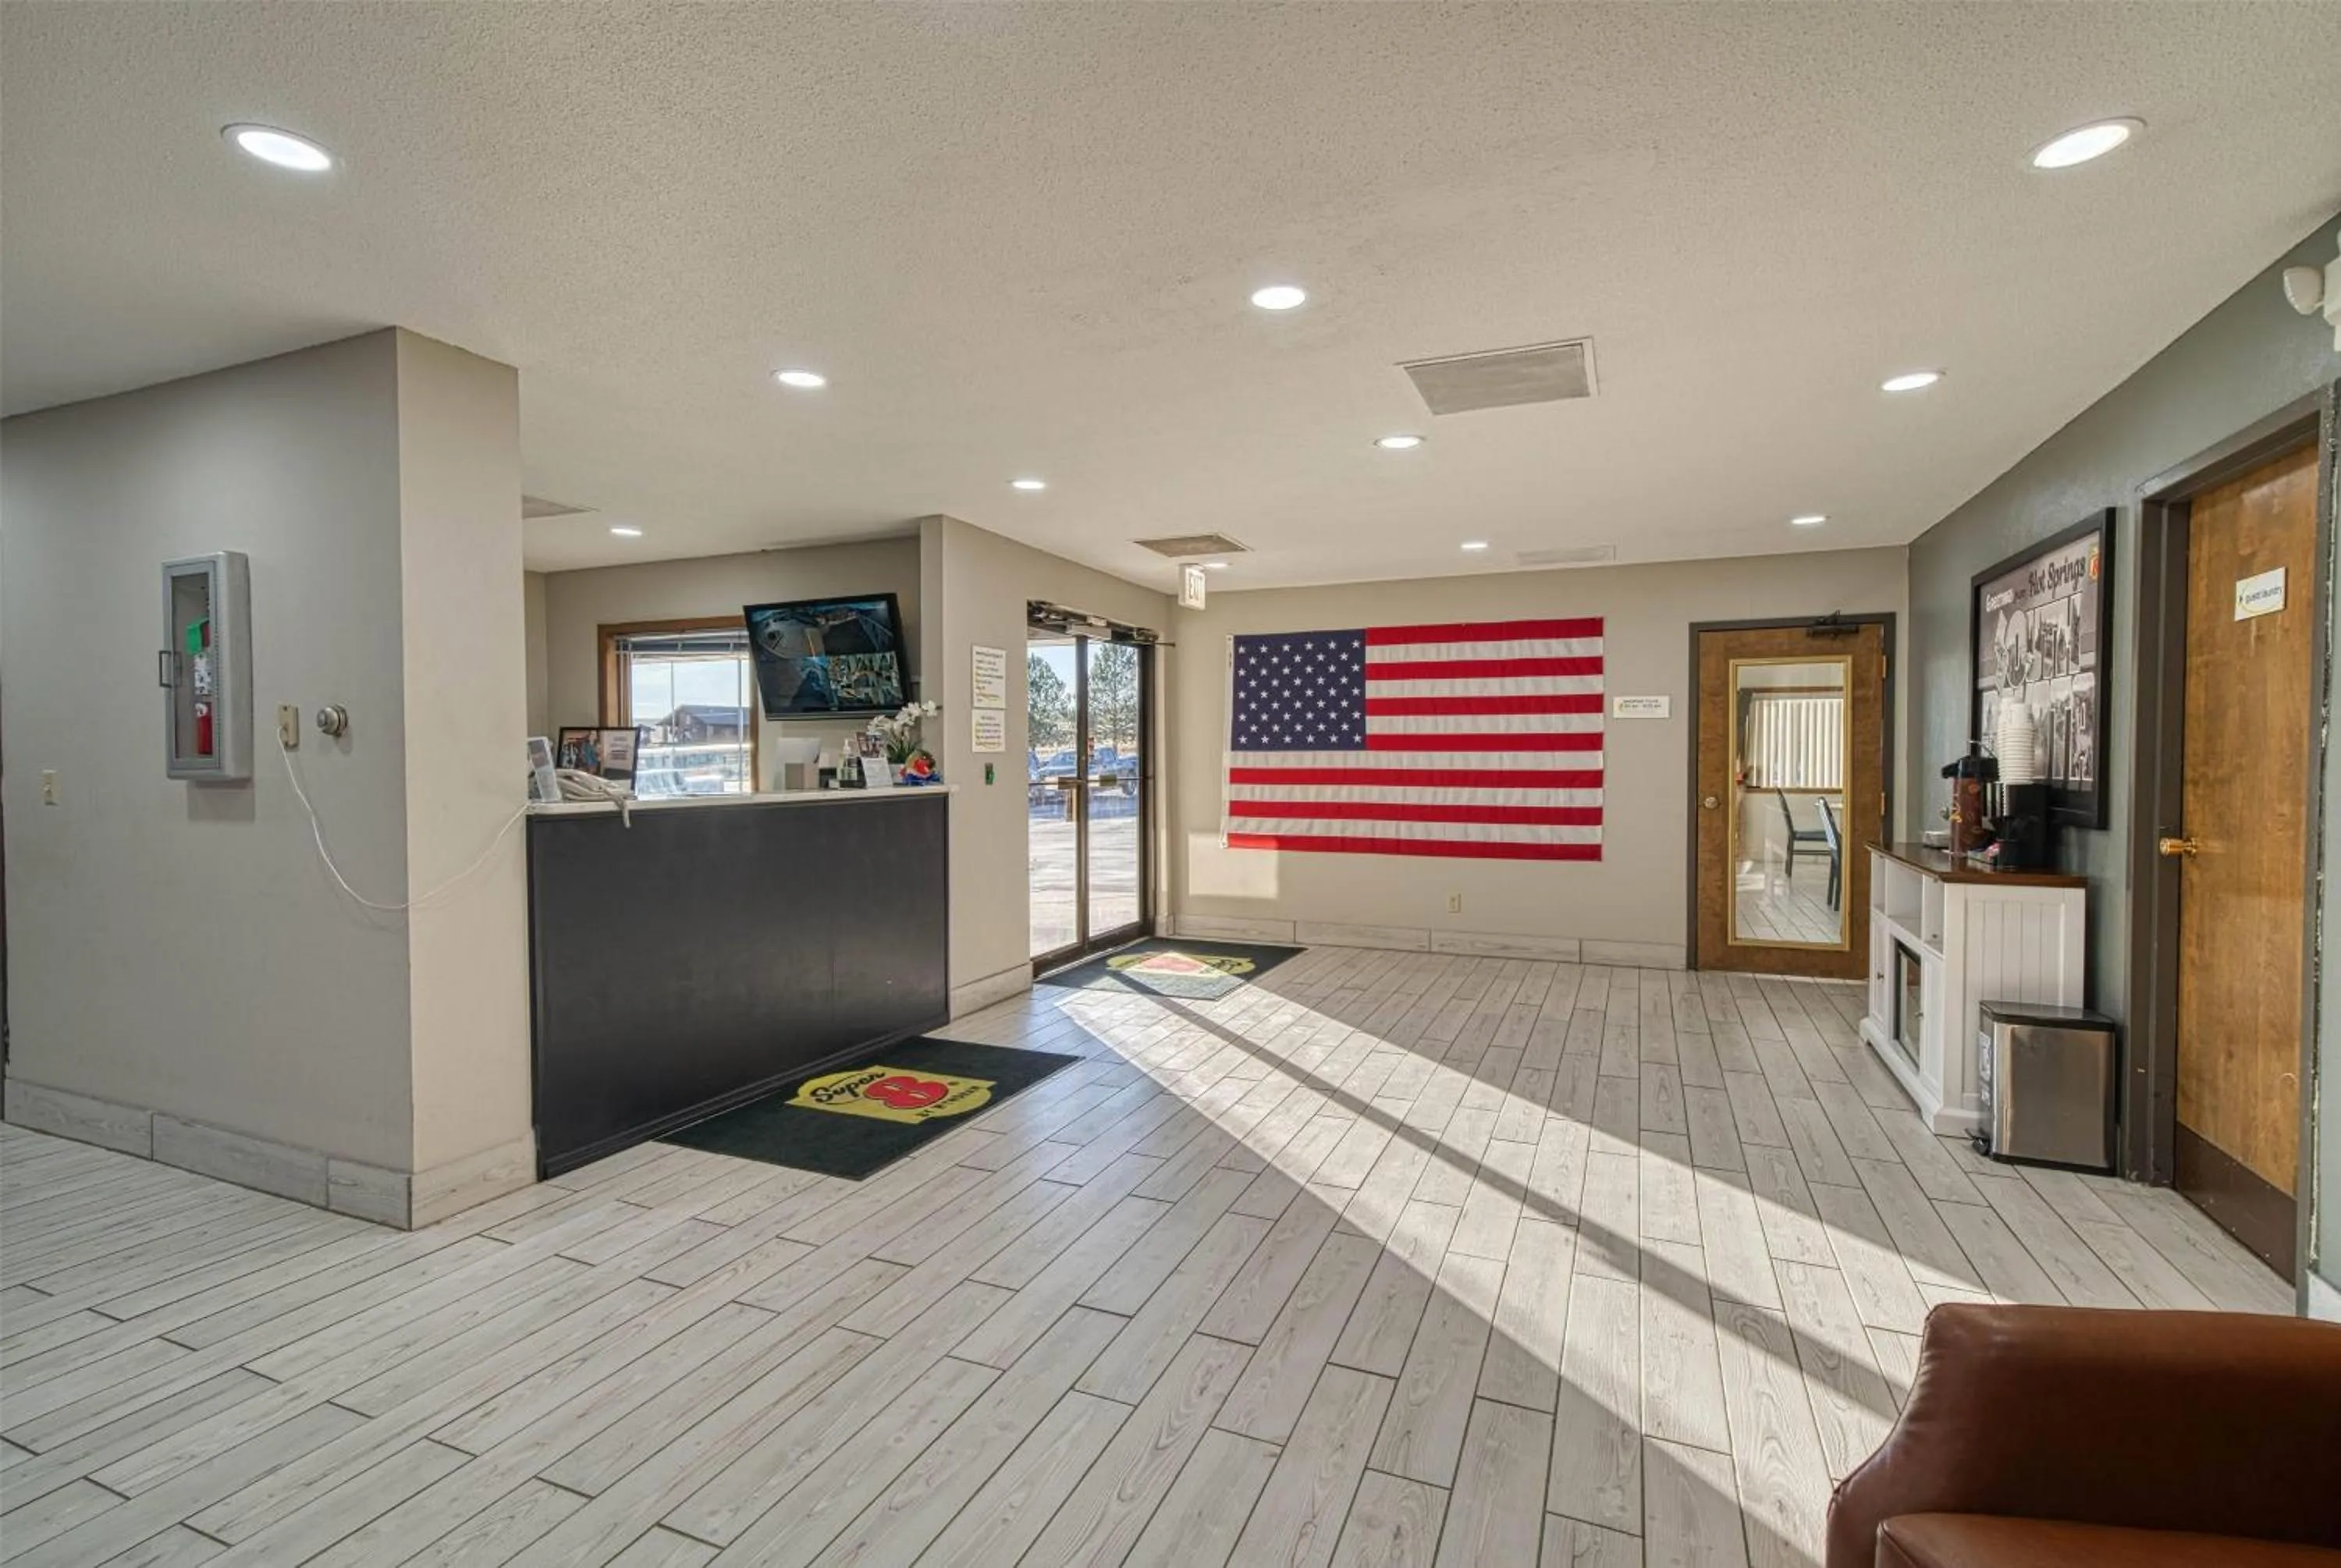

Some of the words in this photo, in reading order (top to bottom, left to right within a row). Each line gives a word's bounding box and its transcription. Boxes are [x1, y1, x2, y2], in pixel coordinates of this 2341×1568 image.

[2047, 555, 2087, 599] Springs
[809, 1072, 886, 1103] Super
[862, 1075, 950, 1109] 8
